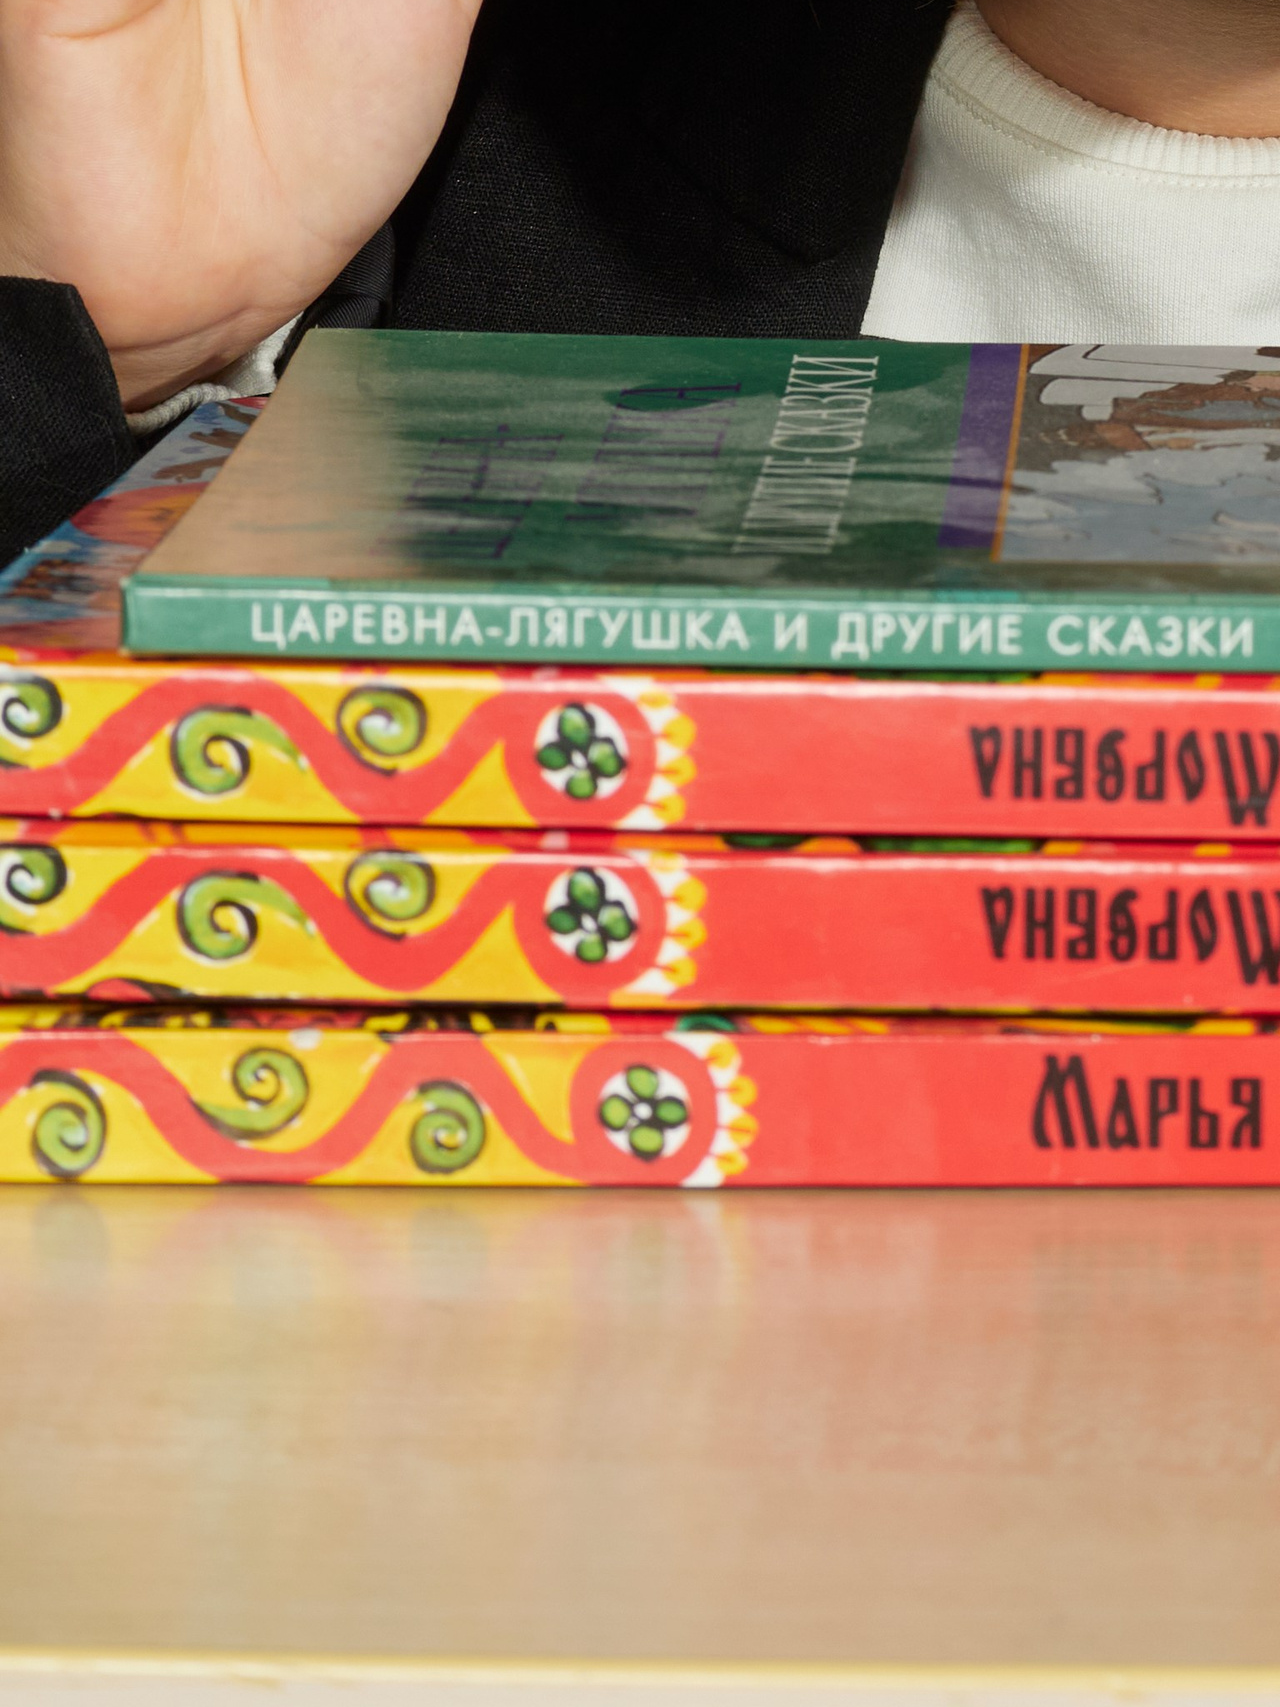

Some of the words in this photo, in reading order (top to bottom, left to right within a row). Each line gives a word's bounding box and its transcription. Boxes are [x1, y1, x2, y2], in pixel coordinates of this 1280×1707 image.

[769, 354, 880, 453] СКАЗКИ
[251, 601, 751, 651] ЦАРЕВНА-ЛЯГУШКА
[773, 611, 808, 652] И
[831, 612, 1023, 662] ДРУГИЕ
[1046, 615, 1254, 658] СКАЗКИ
